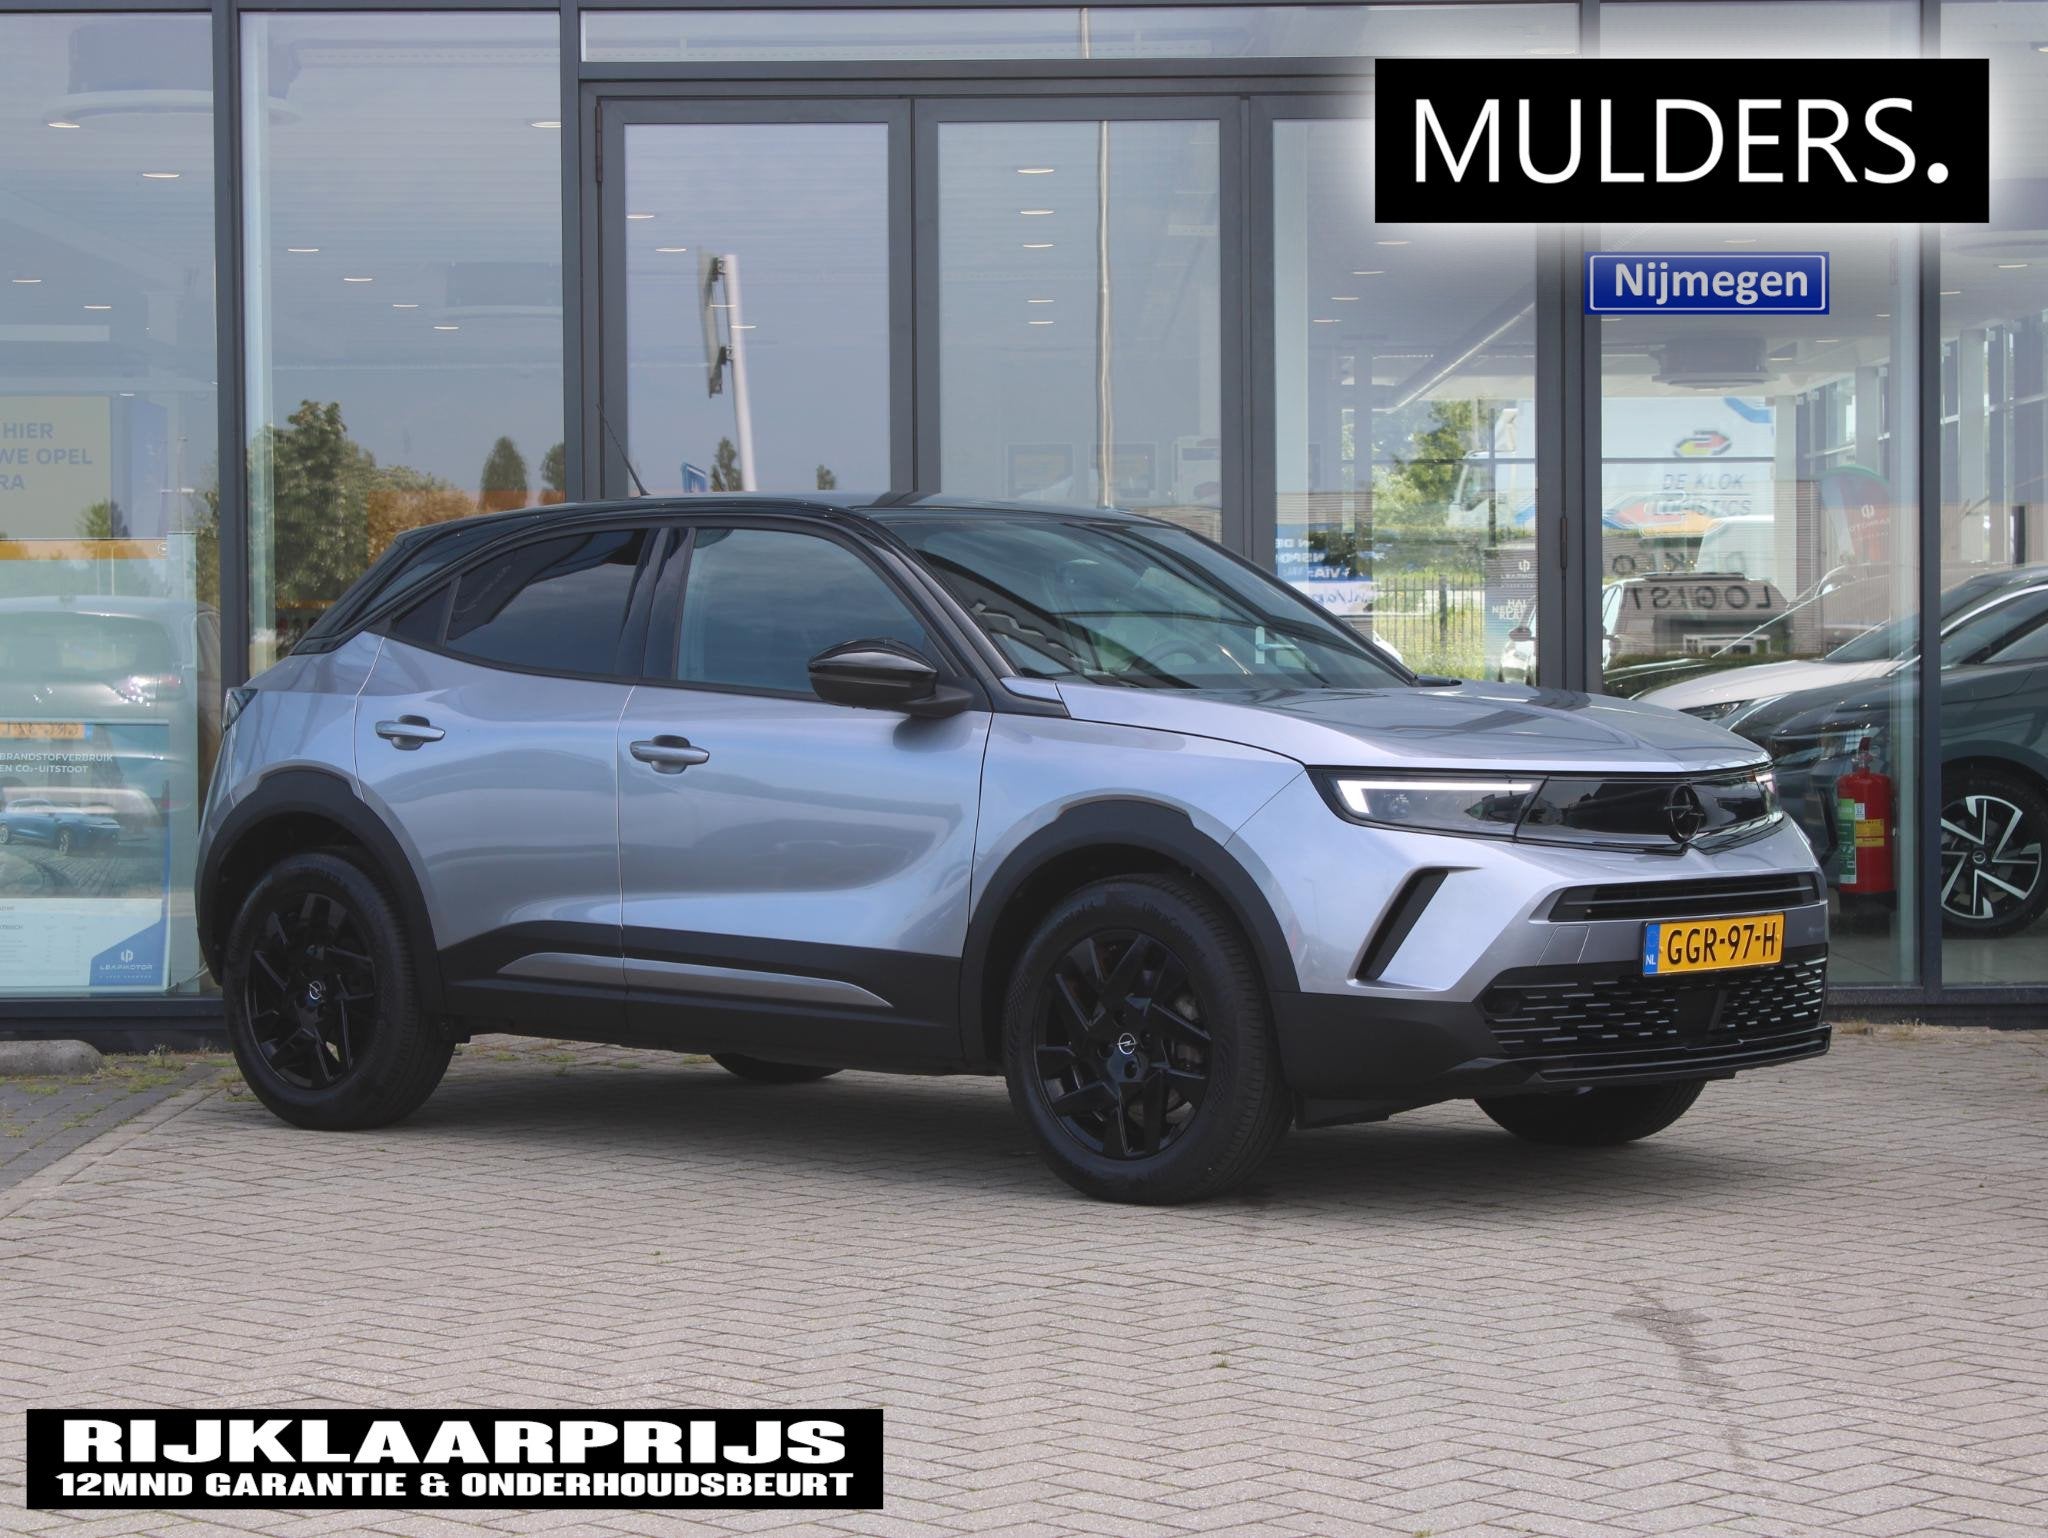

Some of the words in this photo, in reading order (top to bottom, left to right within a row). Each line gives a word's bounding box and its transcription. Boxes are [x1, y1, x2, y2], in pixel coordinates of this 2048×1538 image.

[3, 423, 54, 439] HIER
[36, 448, 93, 464] OPEL
[0, 752, 113, 762] BRANDSTOFVERBRUIK
[0, 765, 12, 773] EN
[1645, 954, 1657, 966] NL
[1667, 921, 1776, 965] GGR-97-H
